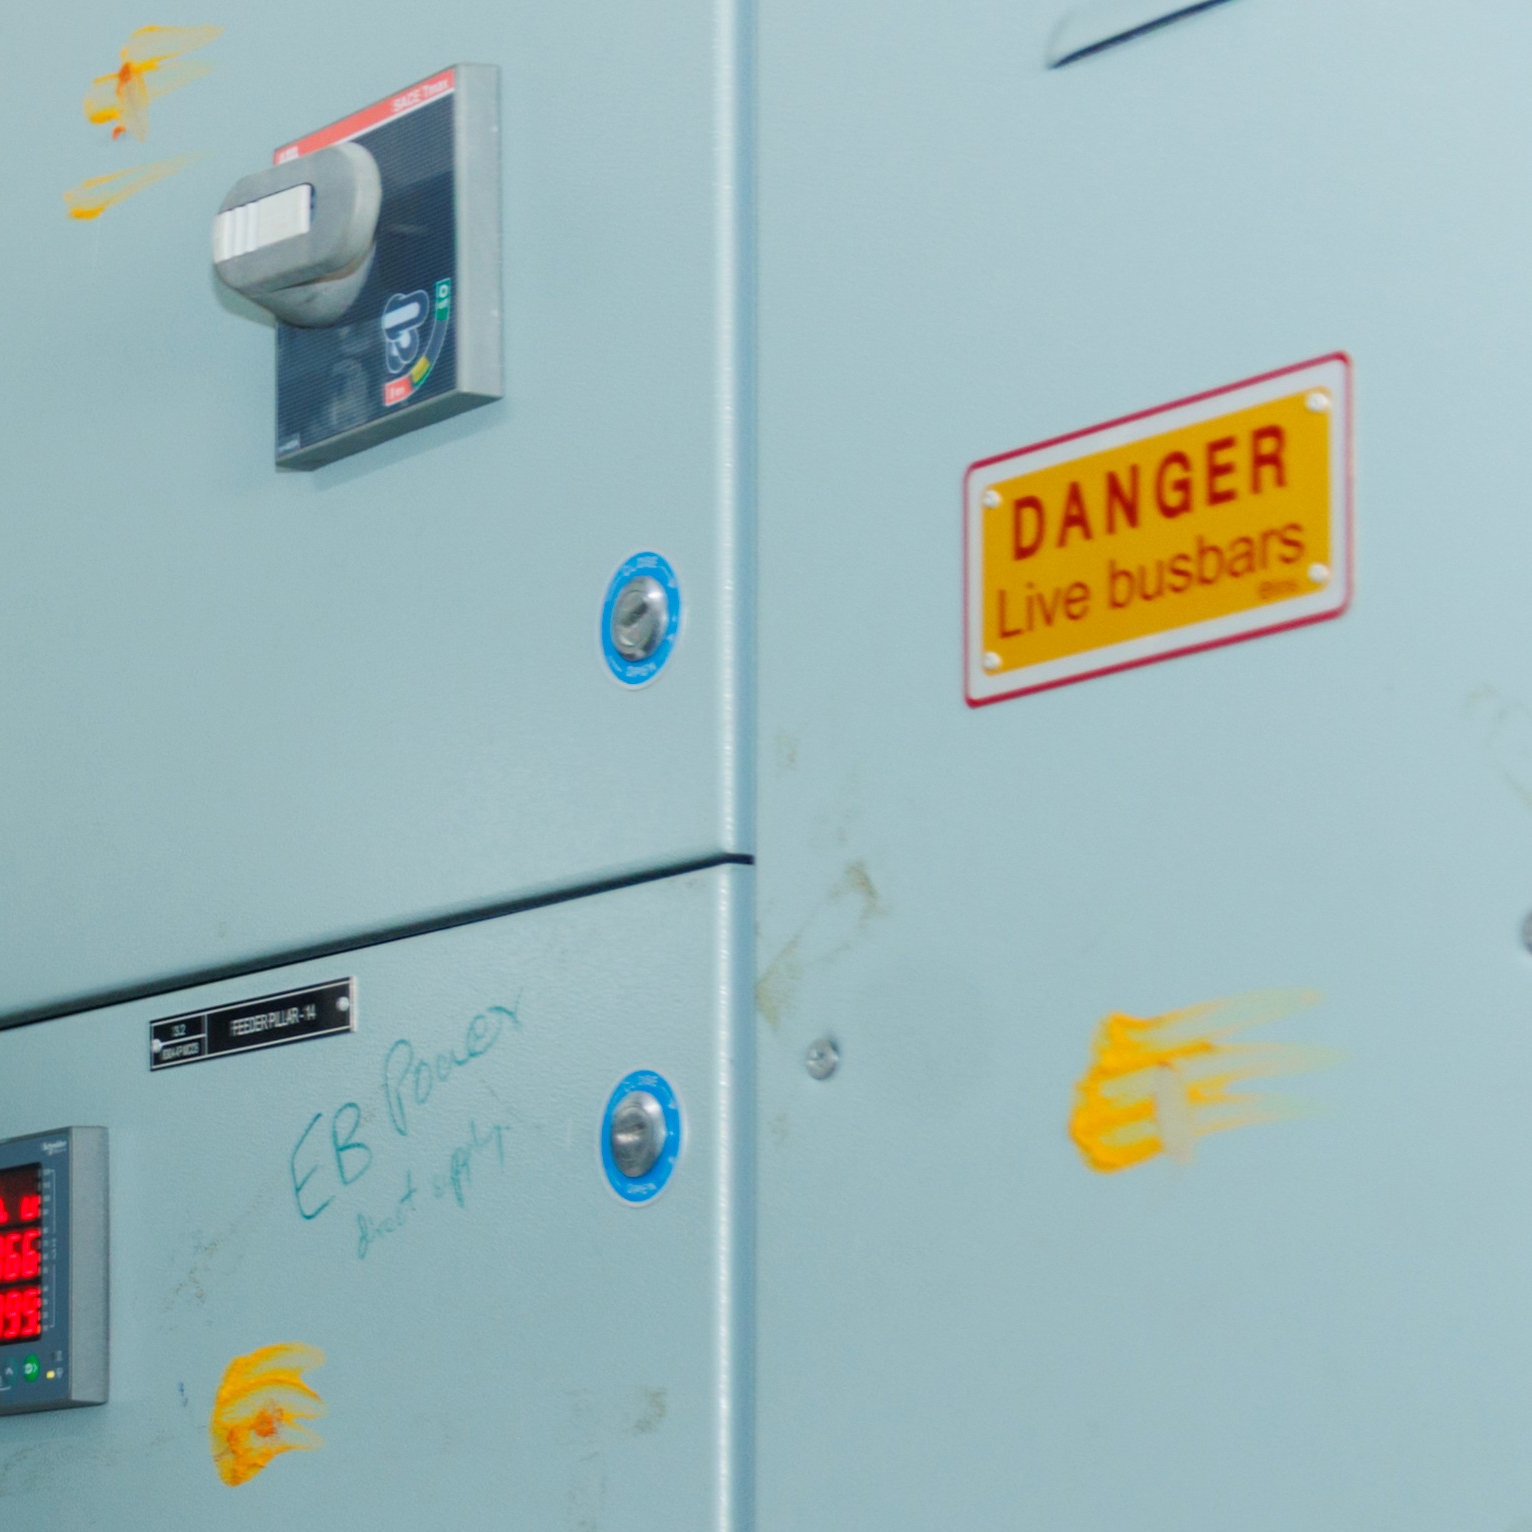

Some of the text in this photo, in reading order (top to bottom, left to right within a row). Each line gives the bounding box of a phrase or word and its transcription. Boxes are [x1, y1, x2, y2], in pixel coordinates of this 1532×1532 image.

[1012, 423, 1287, 561] DANGER
[998, 521, 1305, 639] Live busbars
[231, 1013, 268, 1037] FEEDER
[289, 1101, 374, 1221] EB
